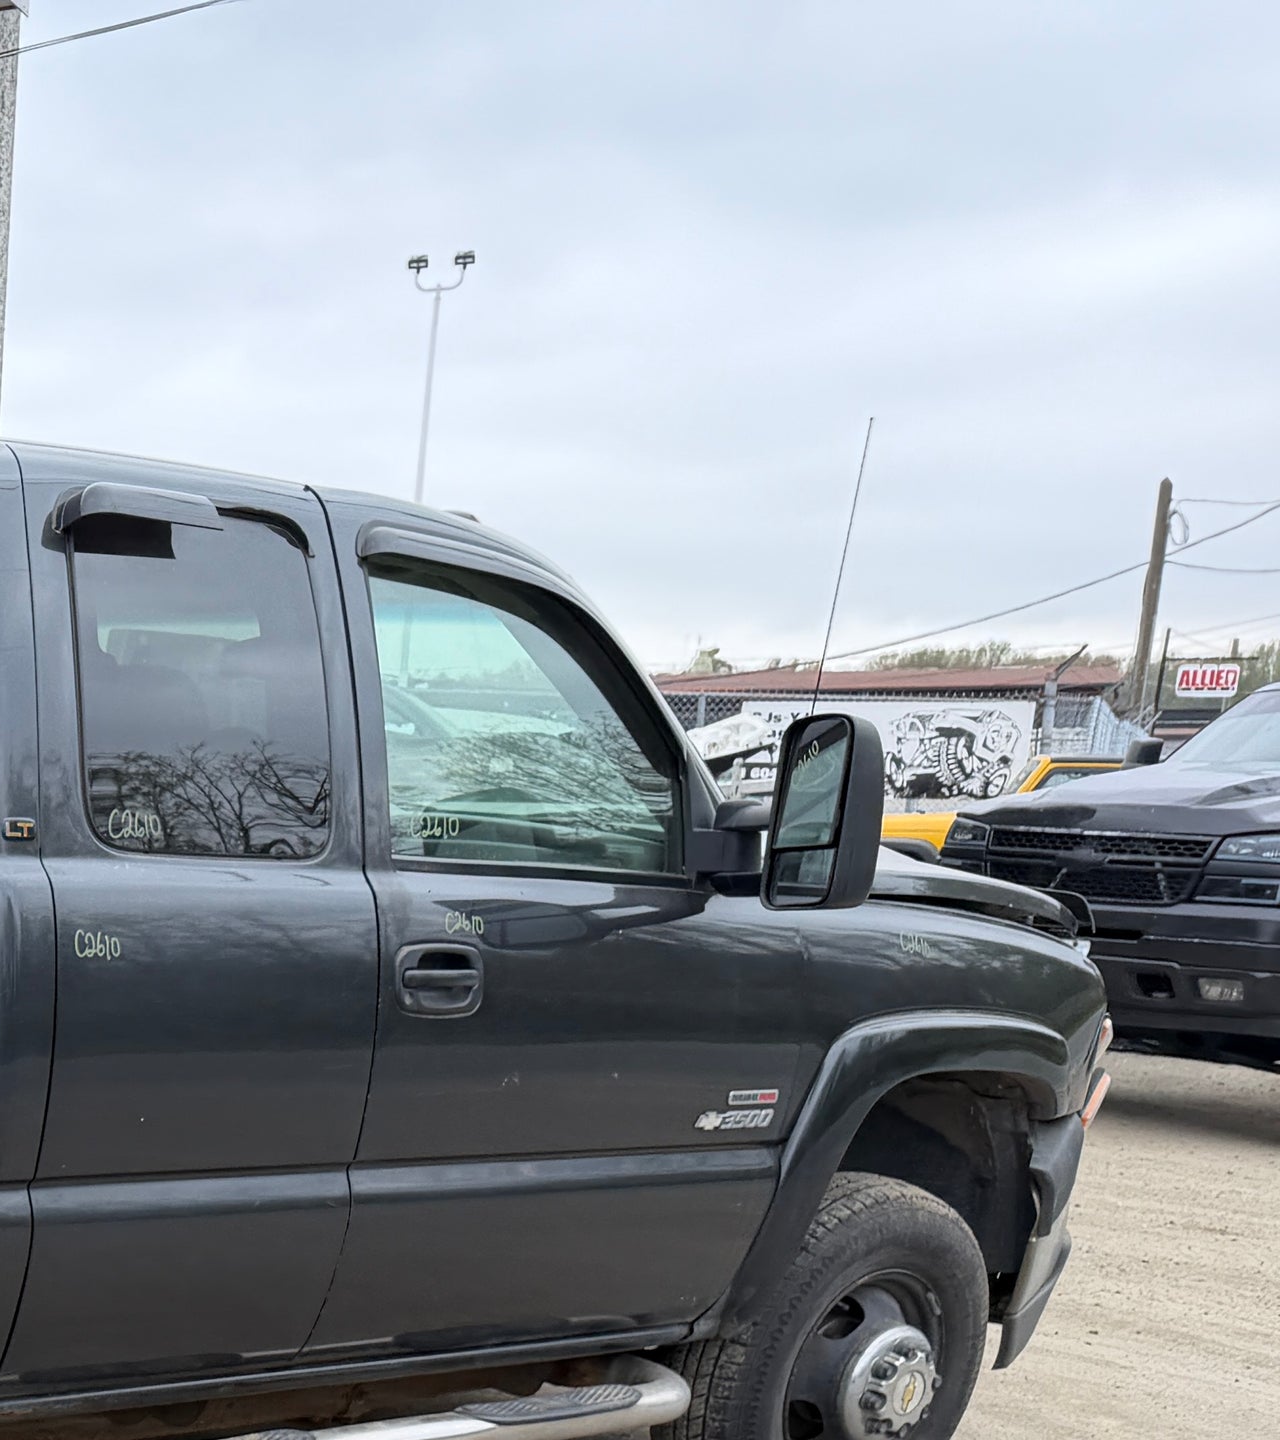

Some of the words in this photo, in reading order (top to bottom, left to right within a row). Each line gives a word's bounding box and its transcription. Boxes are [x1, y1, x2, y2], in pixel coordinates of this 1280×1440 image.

[1178, 669, 1238, 688] ALLIED
[5, 821, 34, 838] LT
[108, 808, 161, 838] C2610
[410, 815, 460, 839] C2610
[445, 911, 484, 934] C2610
[74, 928, 121, 961] C2610
[719, 1109, 774, 1130] 3500
